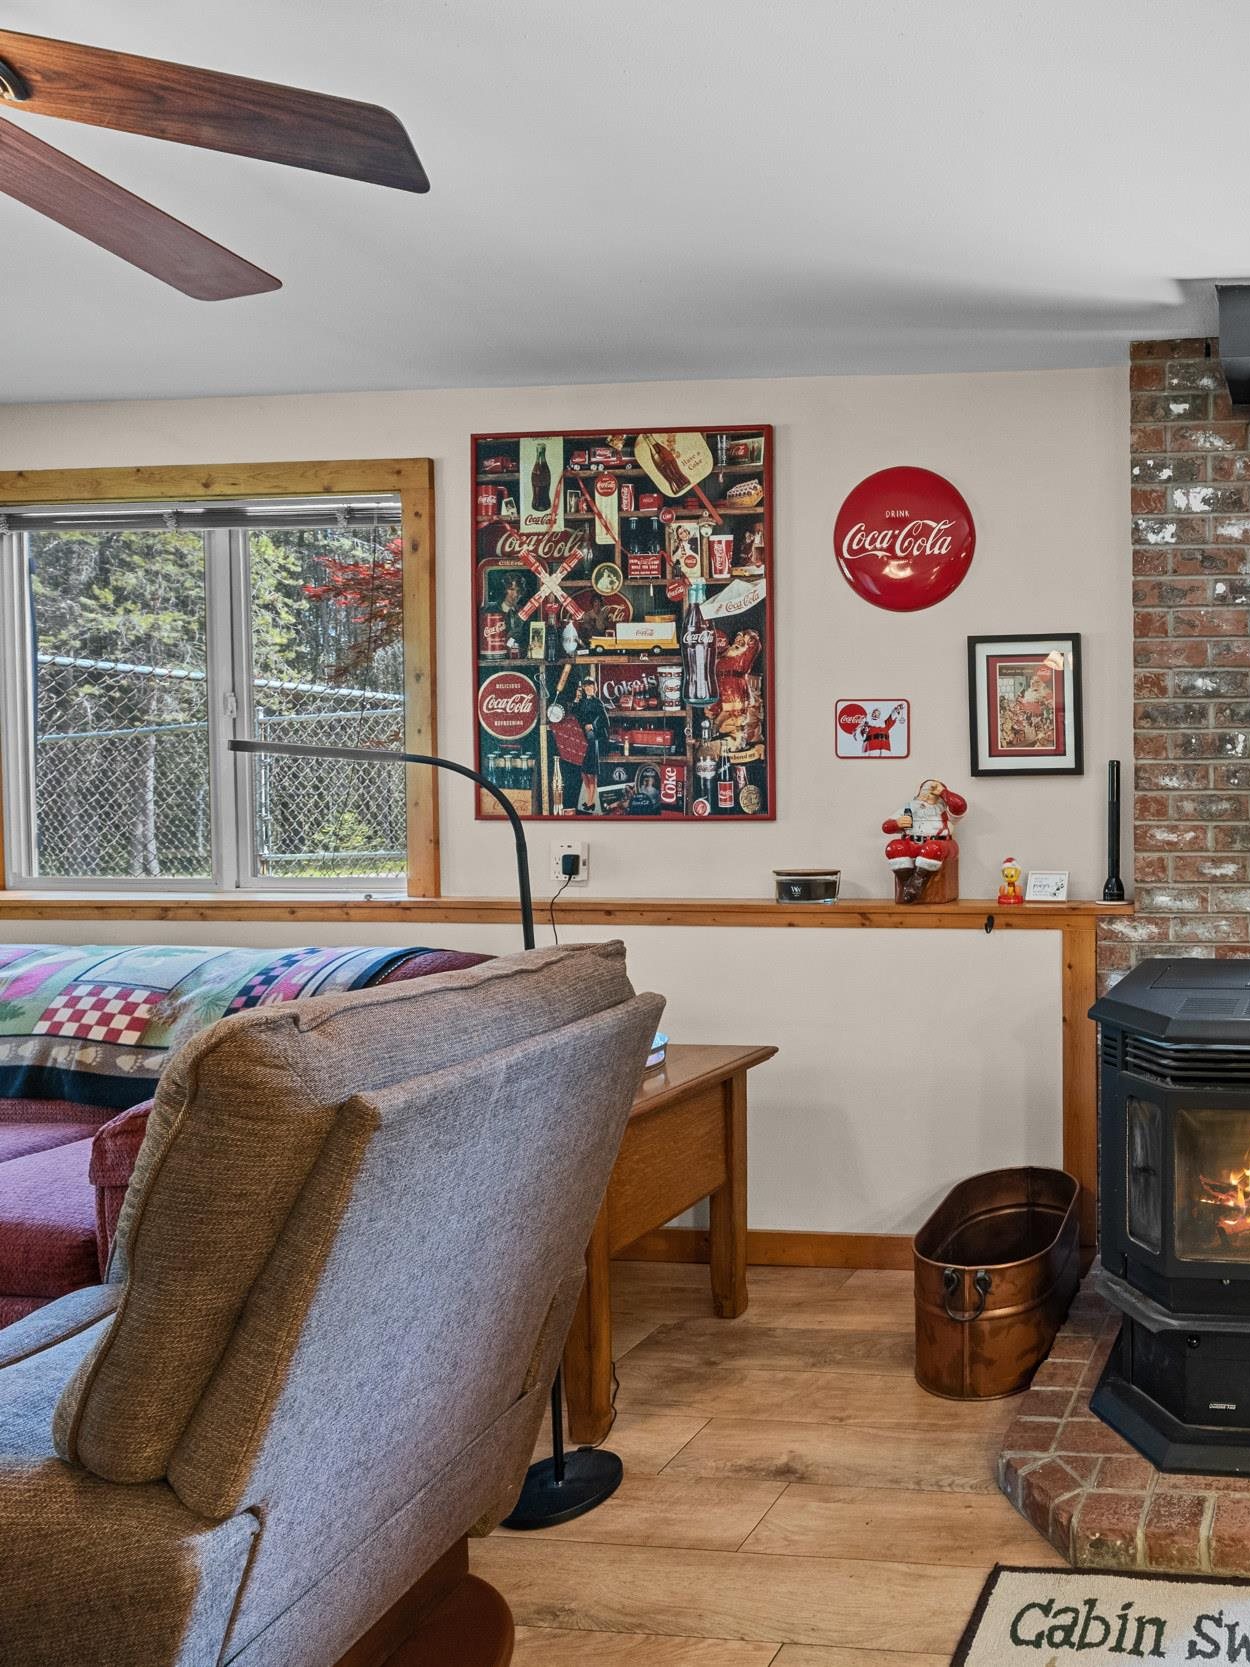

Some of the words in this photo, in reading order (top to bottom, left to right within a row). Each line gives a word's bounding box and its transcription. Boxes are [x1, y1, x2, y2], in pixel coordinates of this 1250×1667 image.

[885, 510, 910, 518] DRINK
[496, 527, 584, 559] Coca-Col
[842, 519, 956, 559] Coca-Cola
[483, 694, 535, 713] Coca-Cola
[660, 767, 677, 803] Coke
[1009, 1598, 1168, 1658] Cabin
